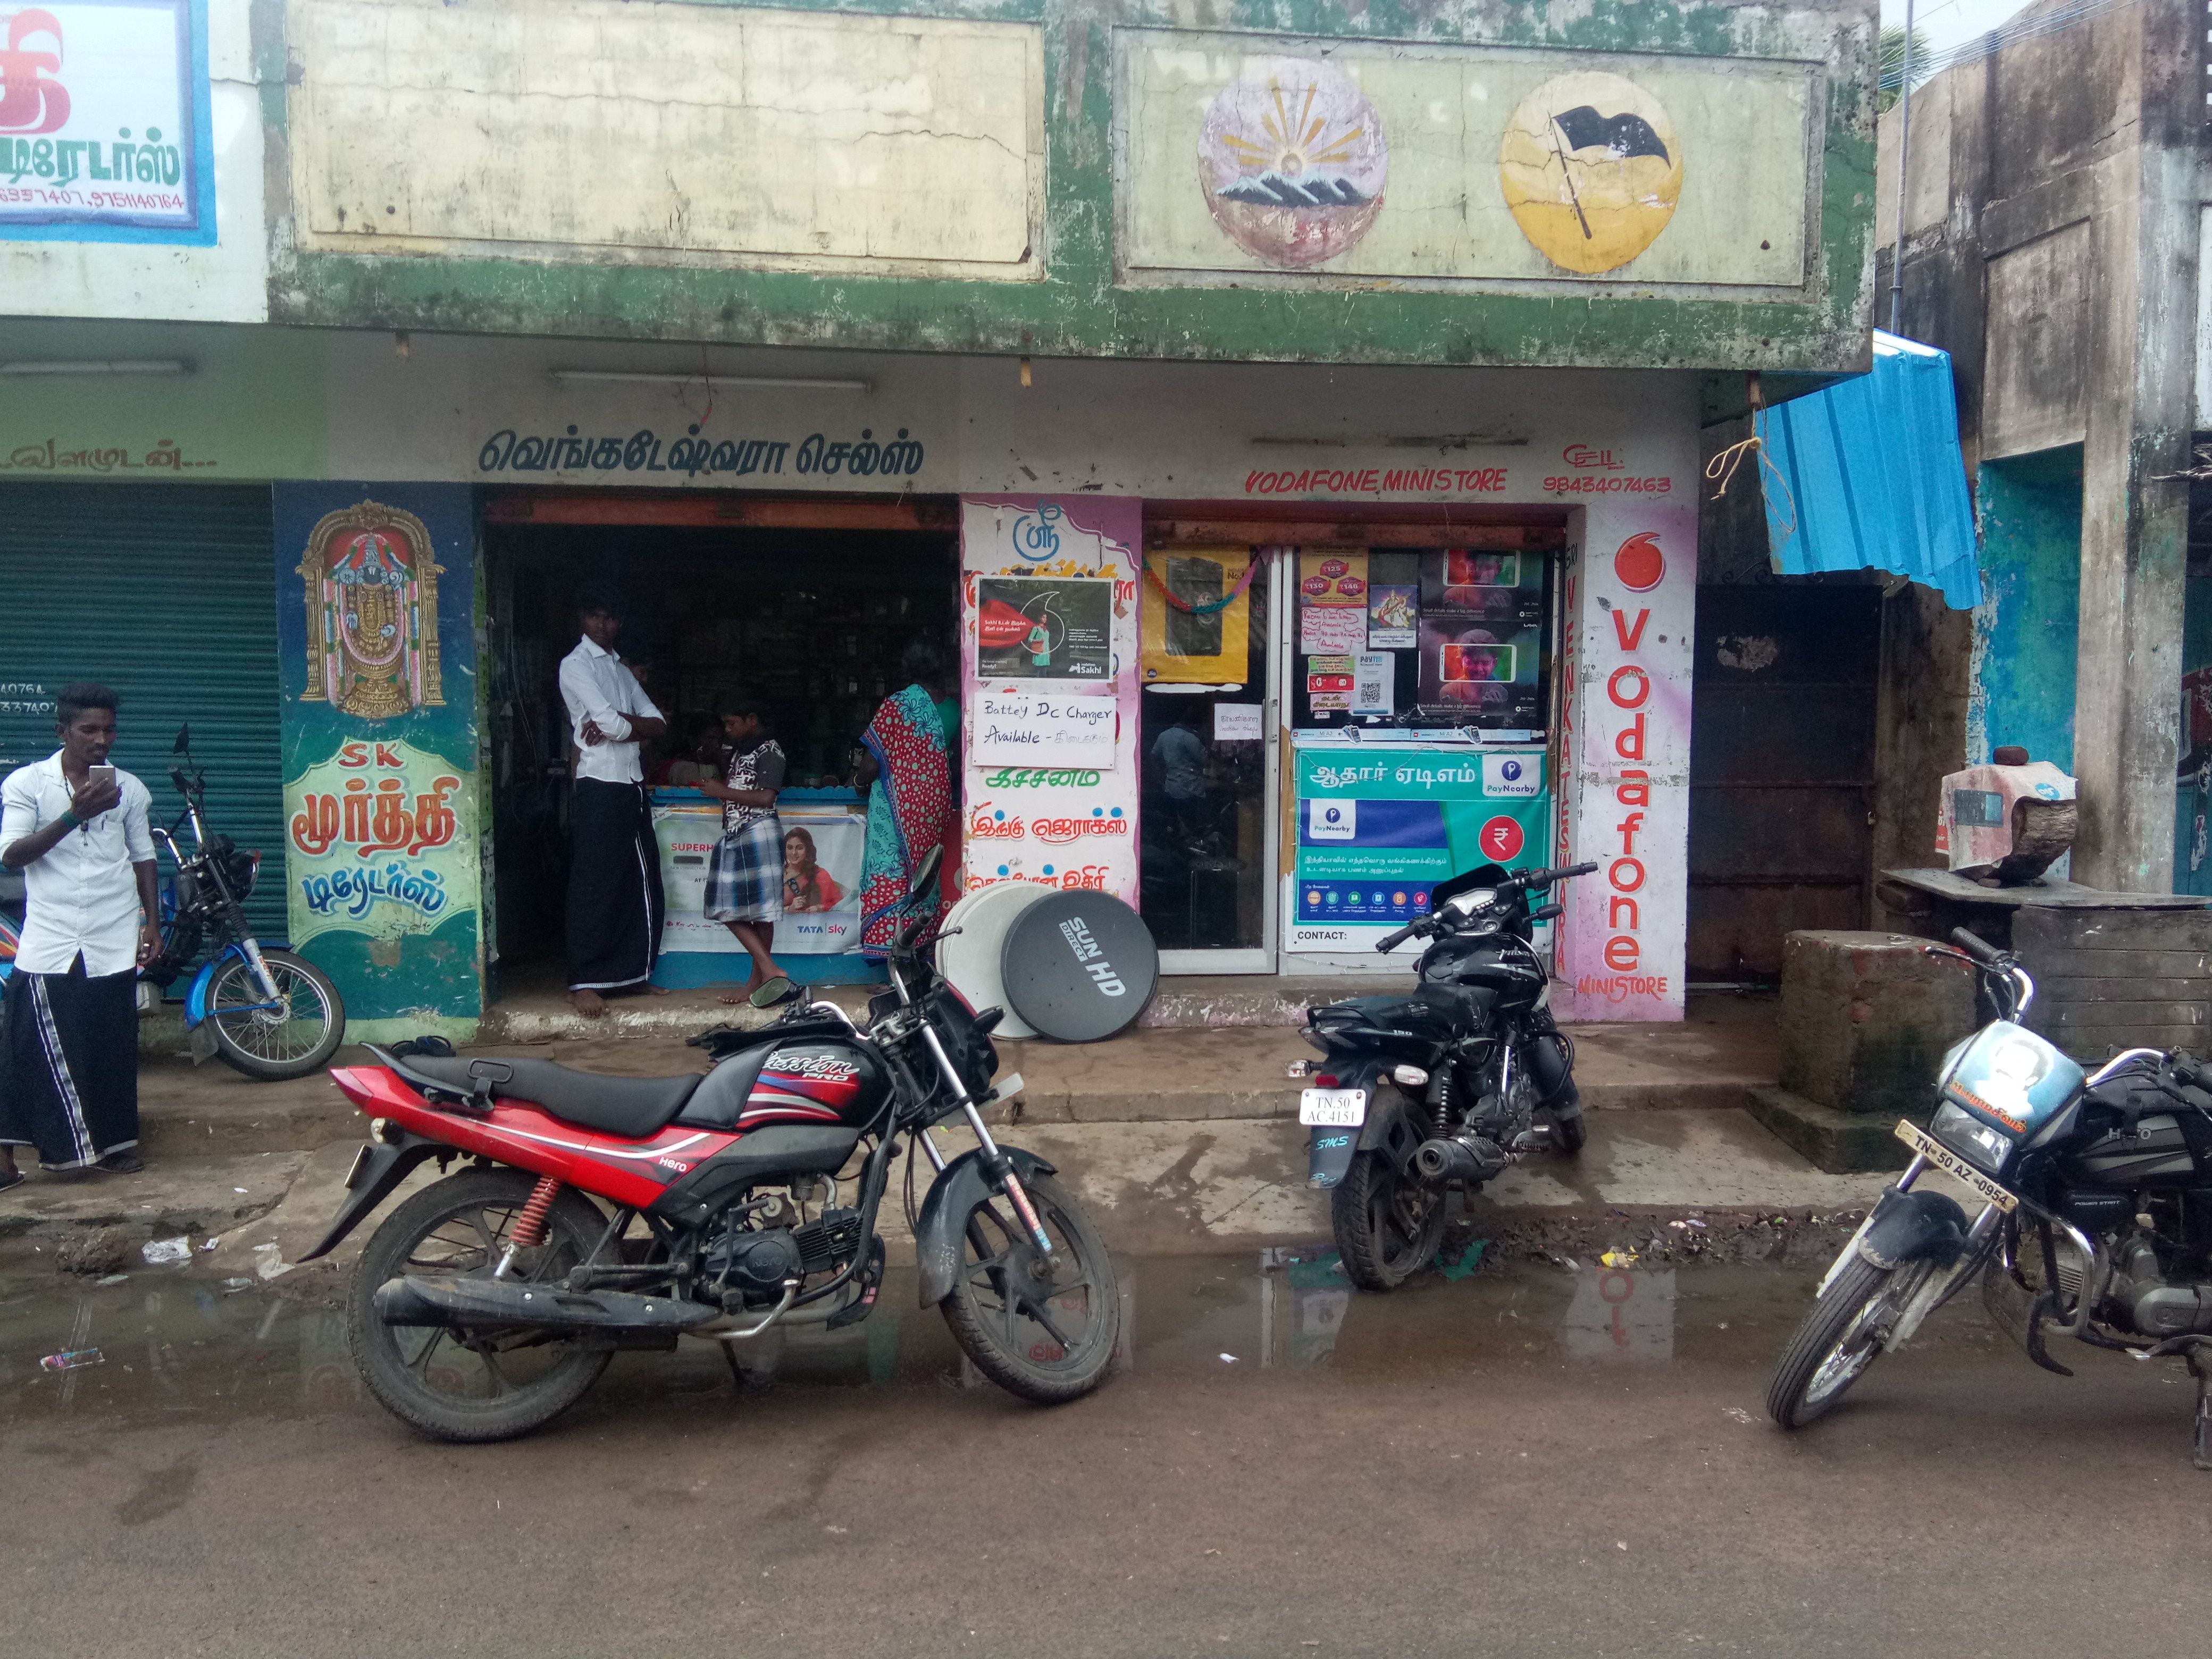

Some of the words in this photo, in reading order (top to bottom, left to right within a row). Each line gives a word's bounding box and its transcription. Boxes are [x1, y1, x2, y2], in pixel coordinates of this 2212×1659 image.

[796, 428, 924, 475] செல்ஸ்
[1245, 470, 1379, 494] VODAFONE
[1543, 476, 1672, 495] 9843407463
[1066, 706, 1112, 725] Charger
[984, 725, 1040, 744] Available
[1309, 761, 1388, 788] ஆதார்
[1395, 763, 1476, 789] ஏடிஎம்
[1487, 784, 1536, 794] PayNearby
[292, 776, 460, 858] மூர்த்தி
[970, 801, 1025, 839] இங்கு
[1032, 807, 1127, 843] ஜெராக்ஸ்
[798, 925, 823, 934] TATA
[828, 925, 848, 935] sky
[1068, 917, 1103, 958] SUN
[1297, 931, 1347, 940] CONTACT:
[1059, 921, 1091, 962] DIRECT
[1085, 961, 1126, 996] HD
[802, 1072, 849, 1081] PRO
[2108, 1128, 2152, 1141] HO
[1953, 1163, 1974, 1183] AZ
